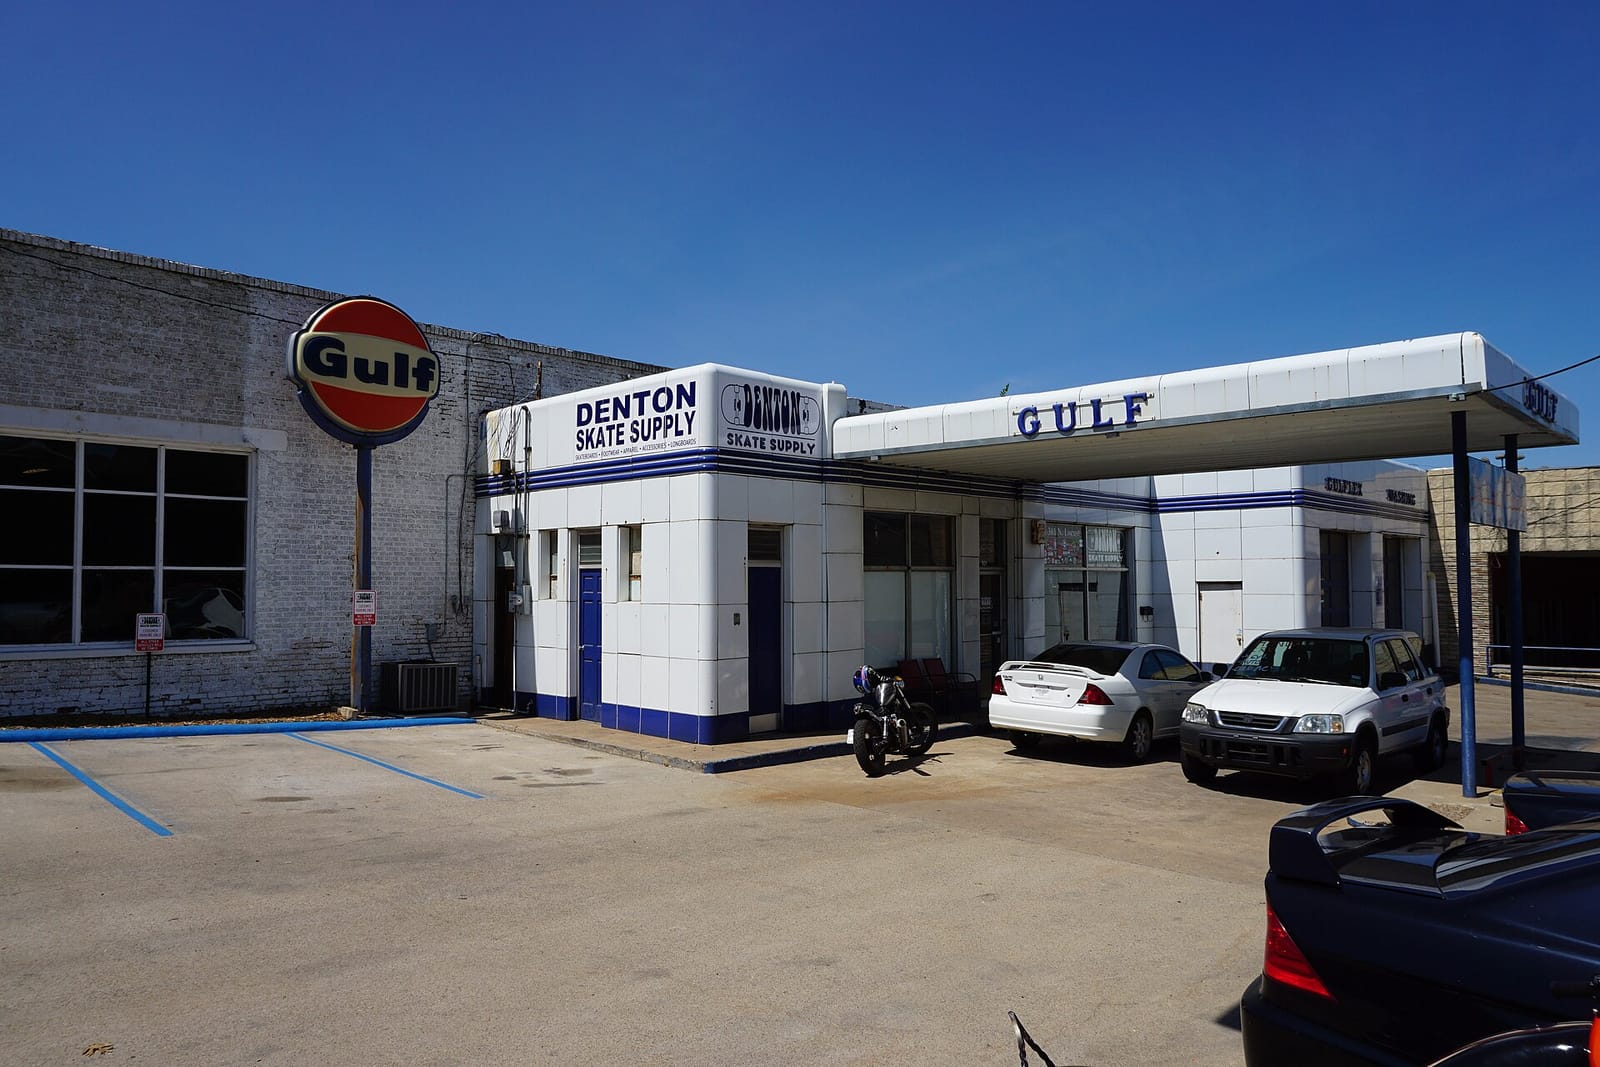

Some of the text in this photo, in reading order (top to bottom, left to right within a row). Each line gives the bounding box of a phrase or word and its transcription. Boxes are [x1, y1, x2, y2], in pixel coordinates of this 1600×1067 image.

[303, 335, 436, 392] Gulf
[576, 380, 697, 427] DENTON
[743, 383, 801, 435] DENTON
[1017, 392, 1147, 436] GULF
[576, 410, 696, 452] SKATE SUPPLY
[670, 437, 697, 448] LONGBOARDS
[727, 432, 816, 455] SKATE SUPPLY
[1088, 553, 1105, 562] SKATE
